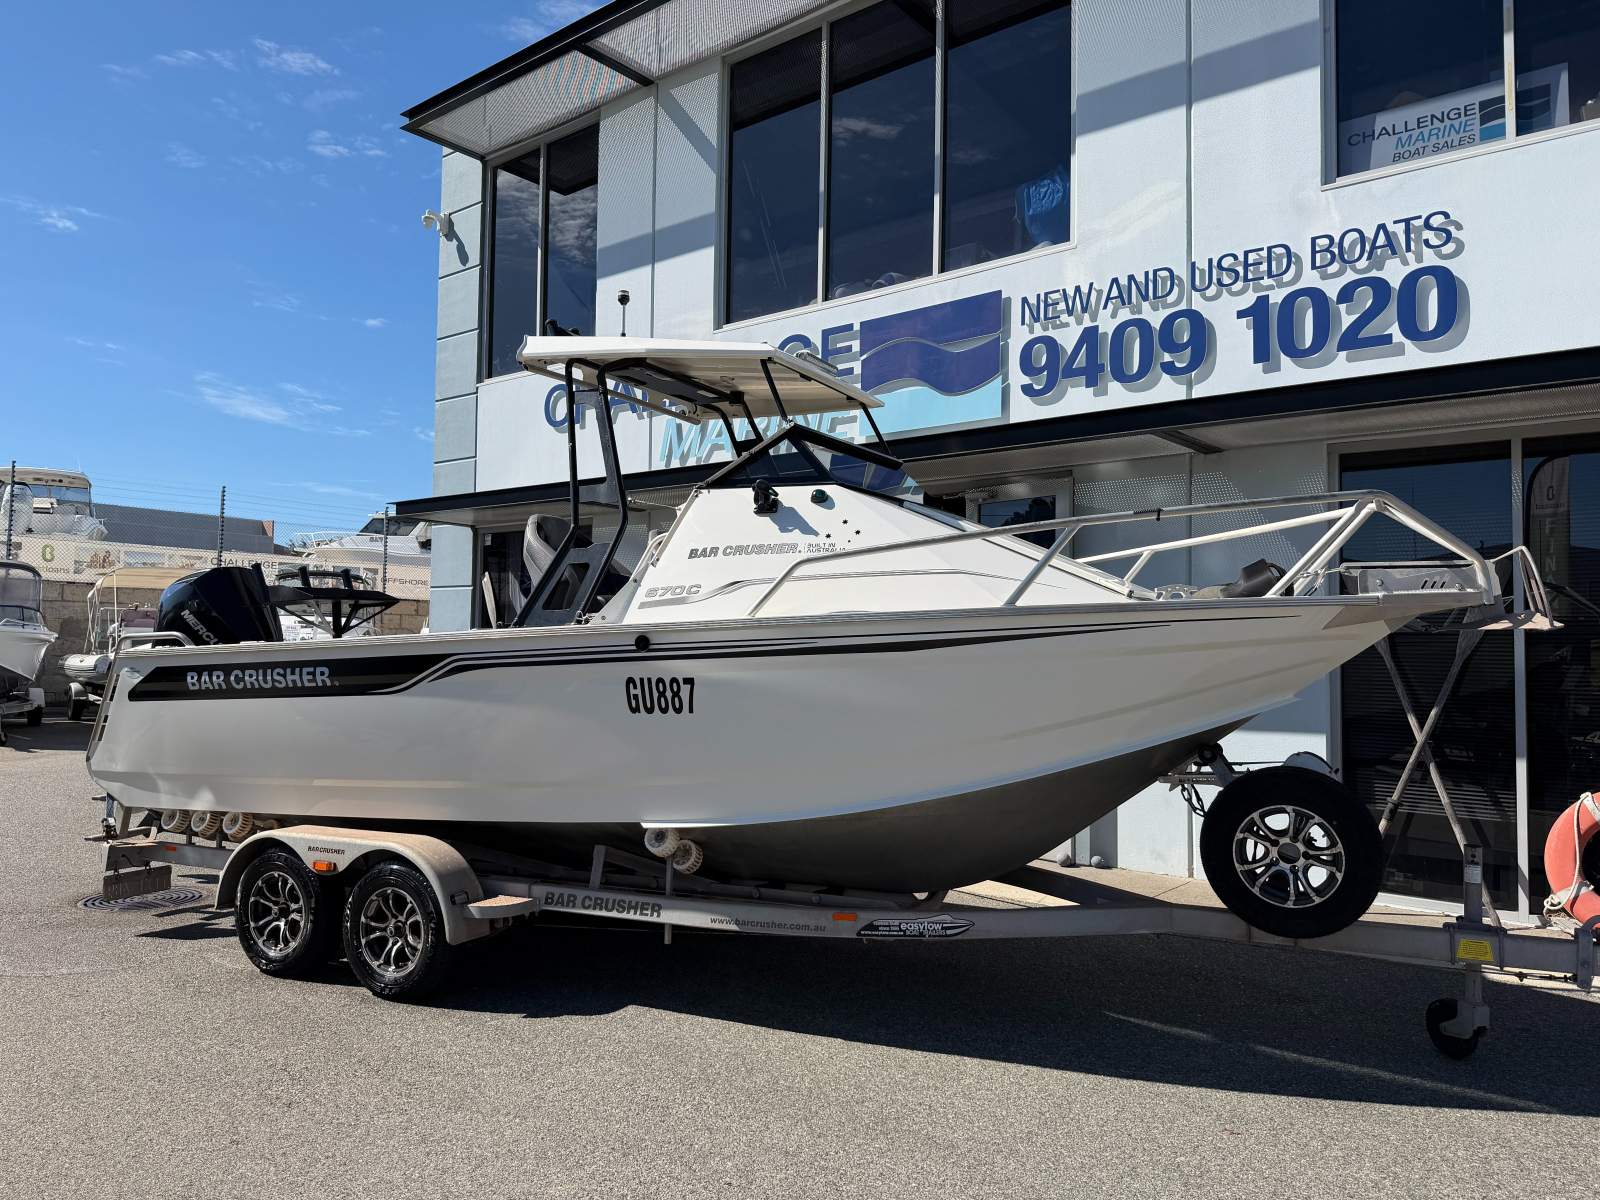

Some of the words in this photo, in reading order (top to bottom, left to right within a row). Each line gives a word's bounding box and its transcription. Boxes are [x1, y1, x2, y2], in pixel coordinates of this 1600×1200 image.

[1347, 103, 1477, 147] CHALLENGE
[1394, 117, 1477, 150] MARINE
[1392, 145, 1429, 163] BOAT
[1431, 133, 1476, 152] SALES
[1020, 281, 1097, 327] NEW
[1102, 266, 1175, 311] AND
[1190, 243, 1293, 293] USED
[1310, 210, 1453, 271] BOATS
[1019, 308, 1208, 398] 9409
[1236, 265, 1458, 365] 1020
[688, 547, 719, 560] BAR
[722, 543, 800, 556] CRUSHER
[645, 584, 702, 598] 670C
[186, 669, 227, 691] BAR
[229, 666, 331, 690] CRUSHER
[625, 676, 695, 715] GU887
[543, 891, 578, 908] BAR
[580, 895, 663, 918] CRUSHER
[710, 917, 827, 932] www.barcrusher.com.au
